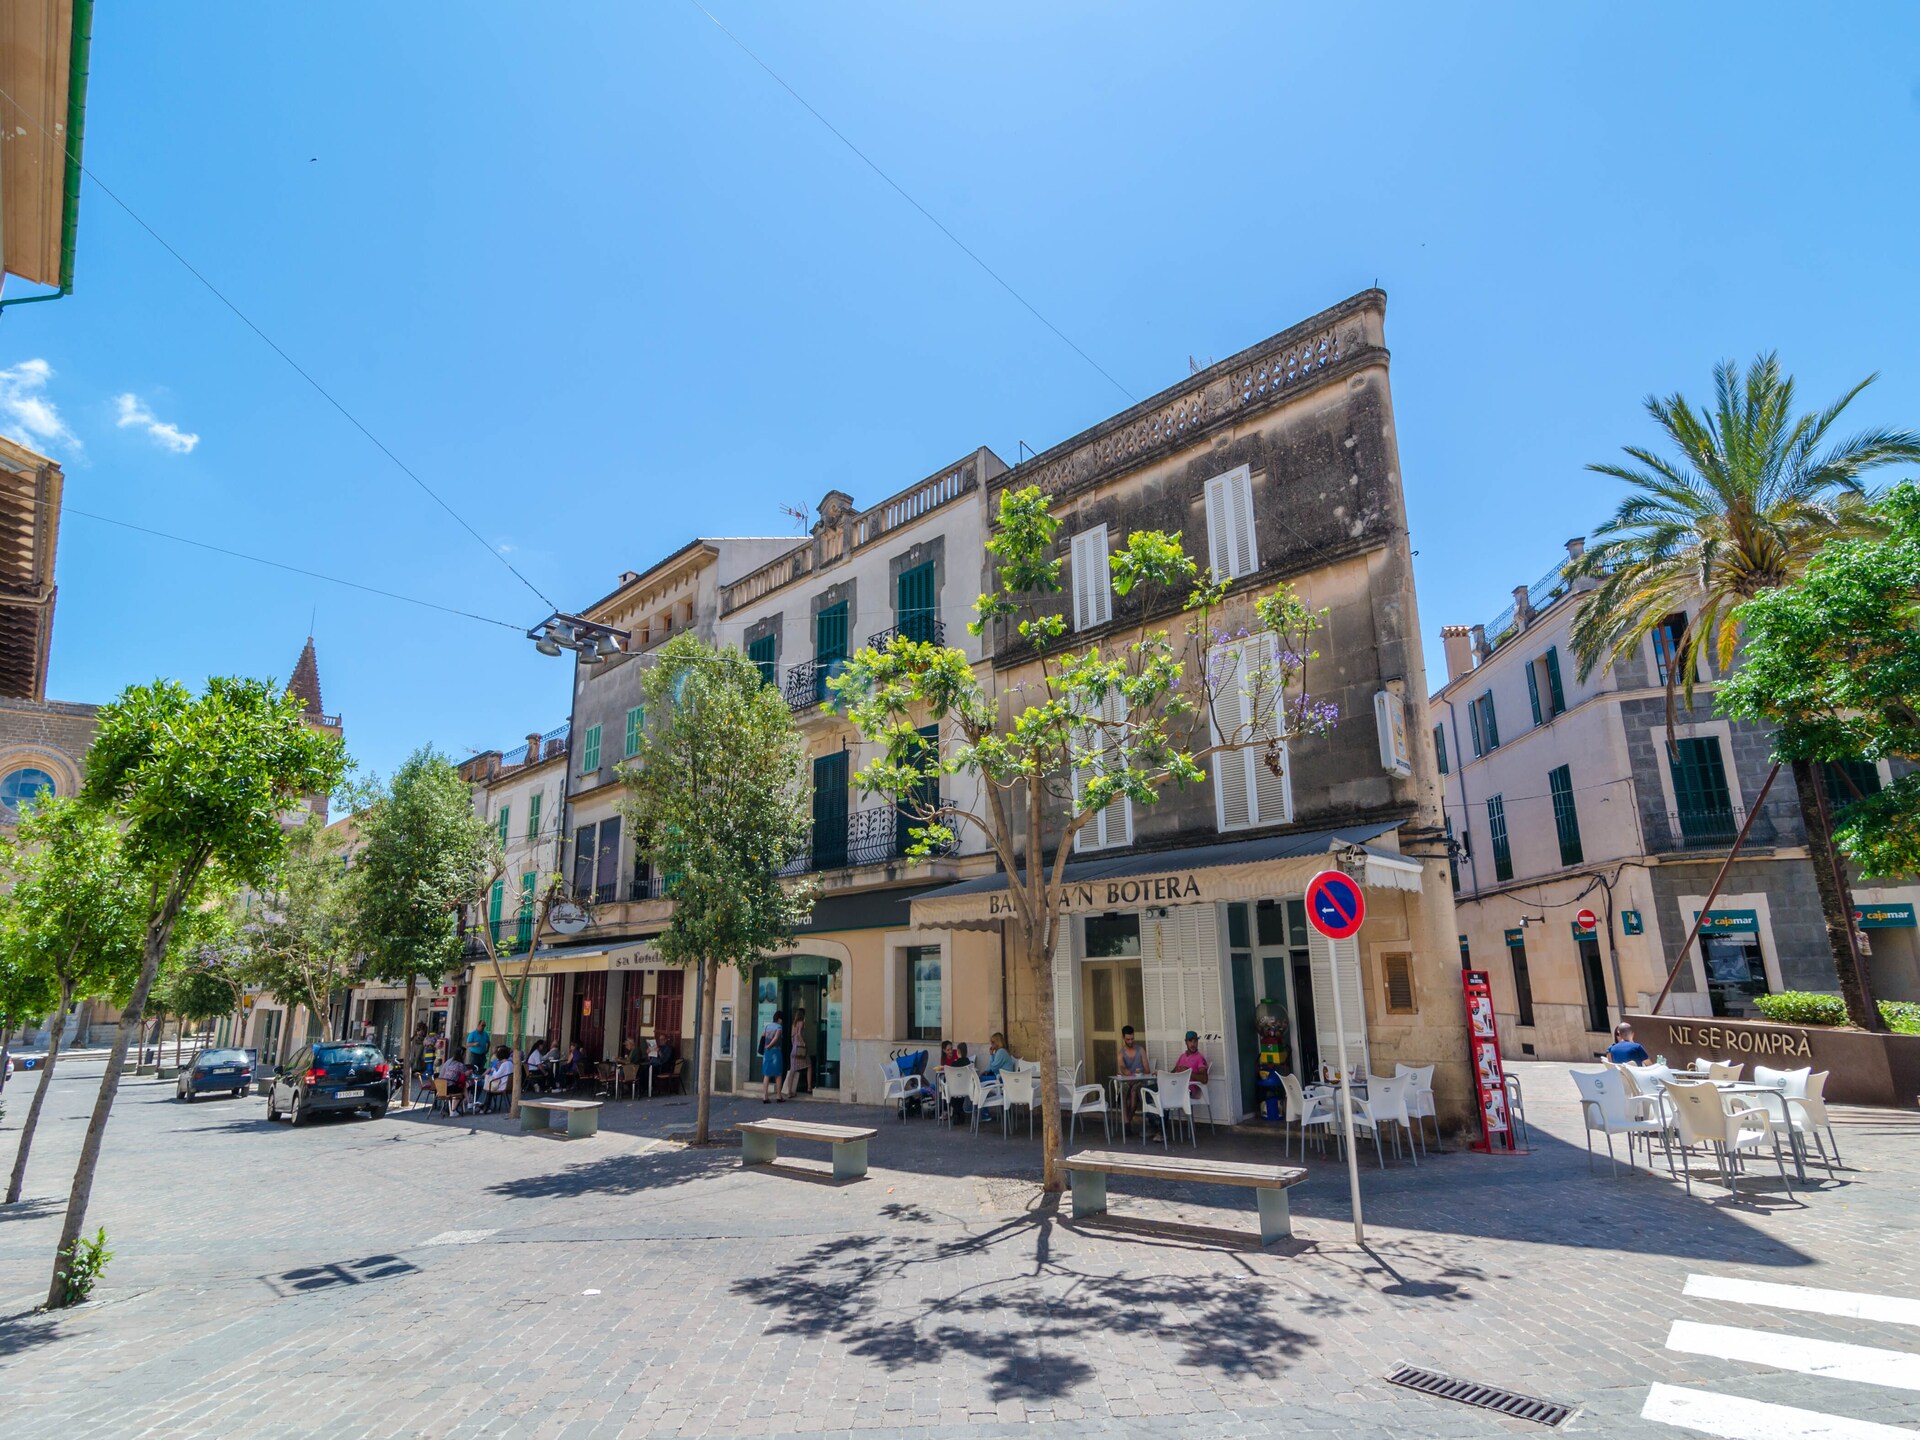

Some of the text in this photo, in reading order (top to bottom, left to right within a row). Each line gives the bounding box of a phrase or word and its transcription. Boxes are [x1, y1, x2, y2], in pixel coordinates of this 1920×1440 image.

[990, 895, 1017, 914] BA
[1107, 874, 1201, 904] BOTERA
[1714, 916, 1753, 927] cajamar
[1866, 910, 1910, 922] cajamar
[615, 956, 630, 967] sa
[633, 951, 663, 965] fond
[1669, 1025, 1812, 1058] NI SE ROMPRÀ
